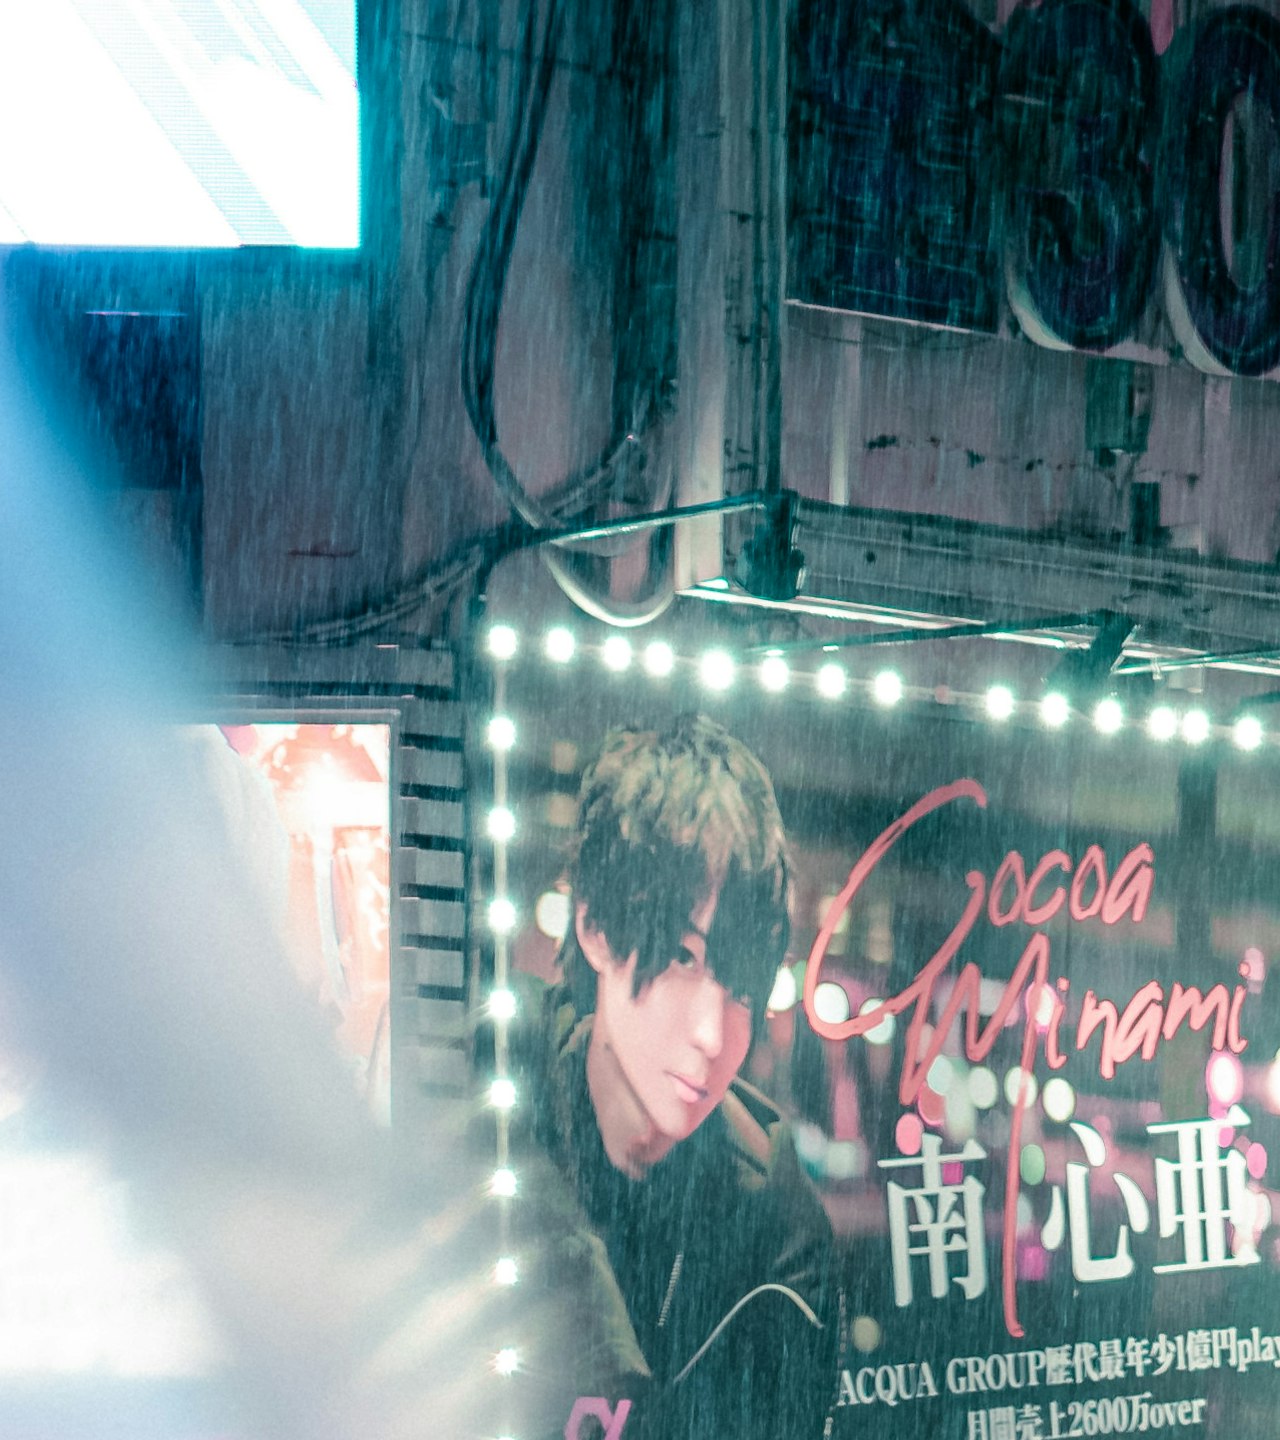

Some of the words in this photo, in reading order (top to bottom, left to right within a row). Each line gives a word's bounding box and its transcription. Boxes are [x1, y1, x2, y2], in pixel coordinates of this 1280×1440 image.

[804, 776, 1154, 1043] Cocoa
[876, 1132, 988, 1308] 南
[1040, 1106, 1263, 1284] 心亜
[837, 1362, 939, 1408] ACQUA
